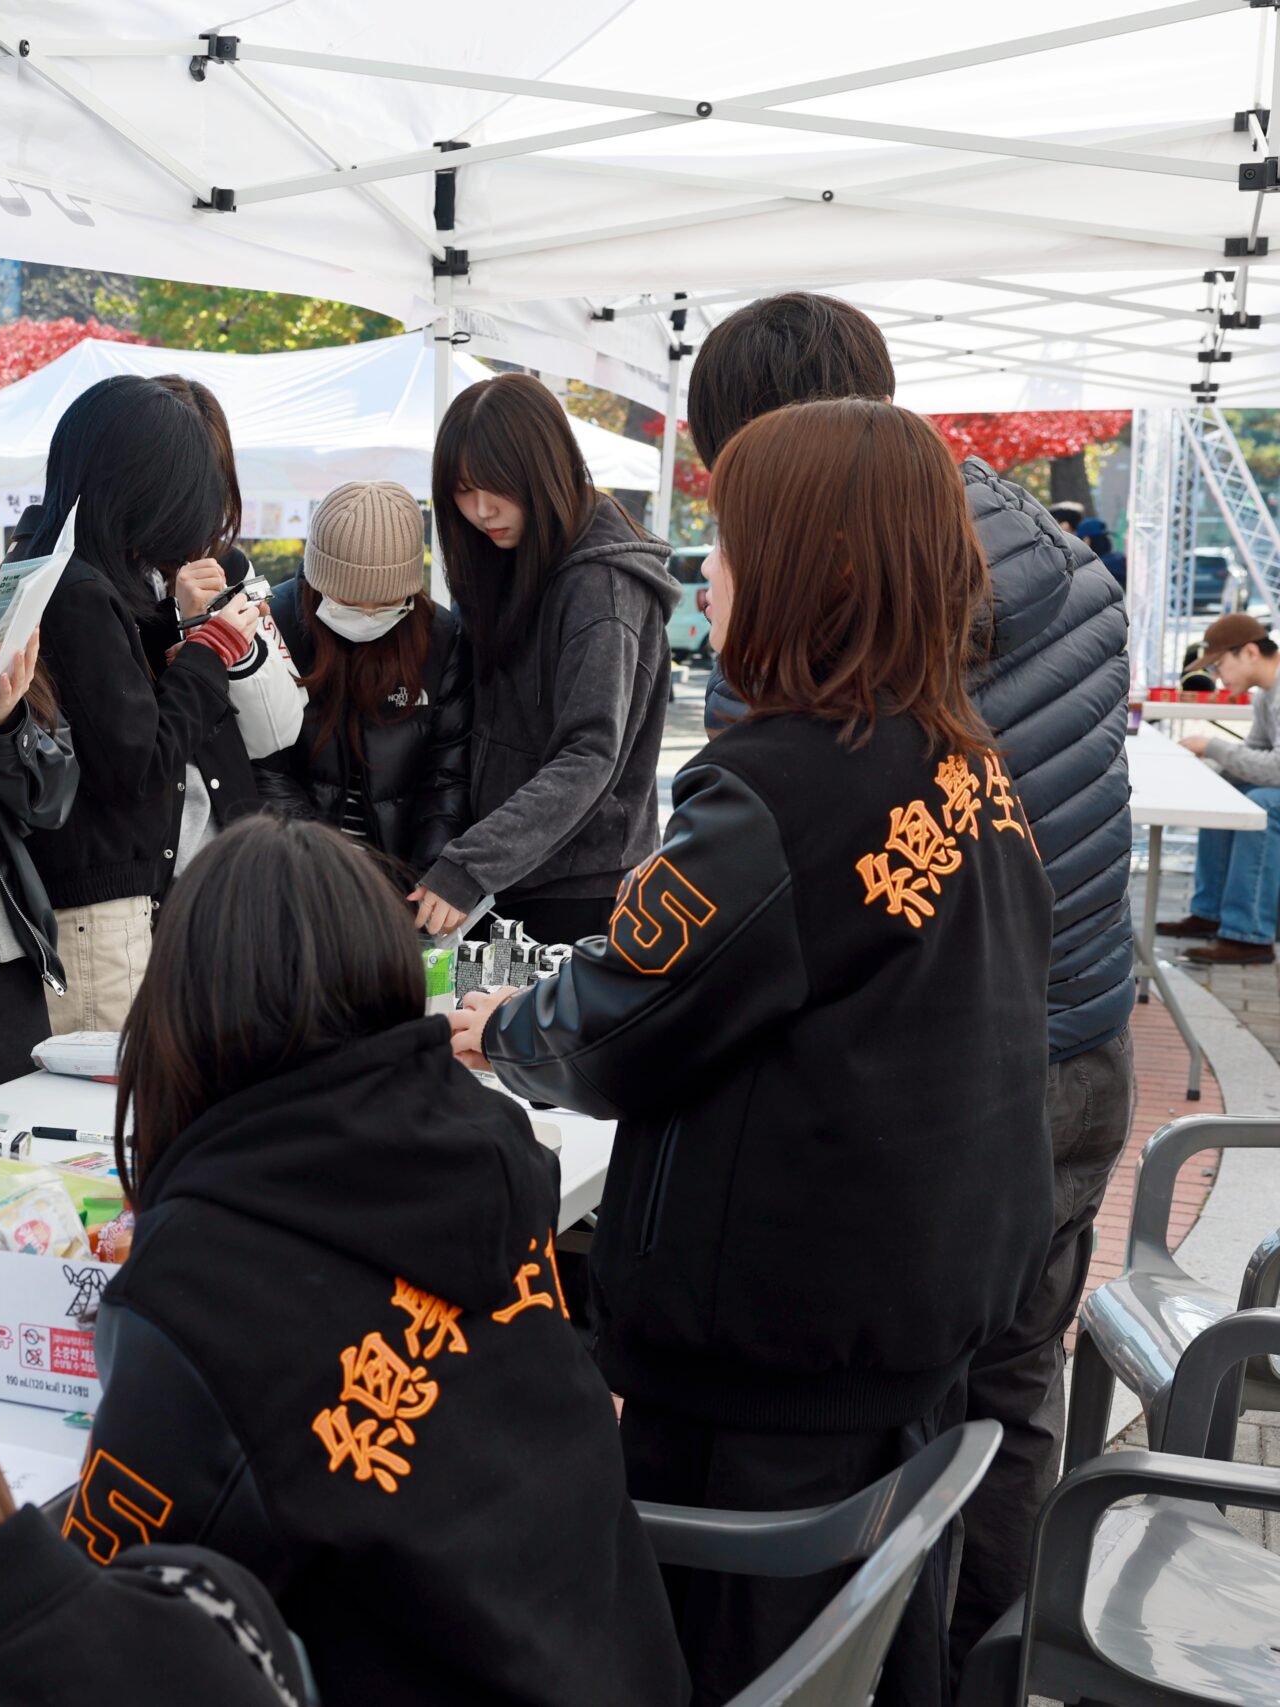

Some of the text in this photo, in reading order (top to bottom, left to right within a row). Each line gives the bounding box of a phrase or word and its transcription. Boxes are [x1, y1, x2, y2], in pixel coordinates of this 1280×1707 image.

[609, 855, 717, 974] 5
[6, 1374, 18, 1387] 190
[61, 1432, 173, 1565] 5
